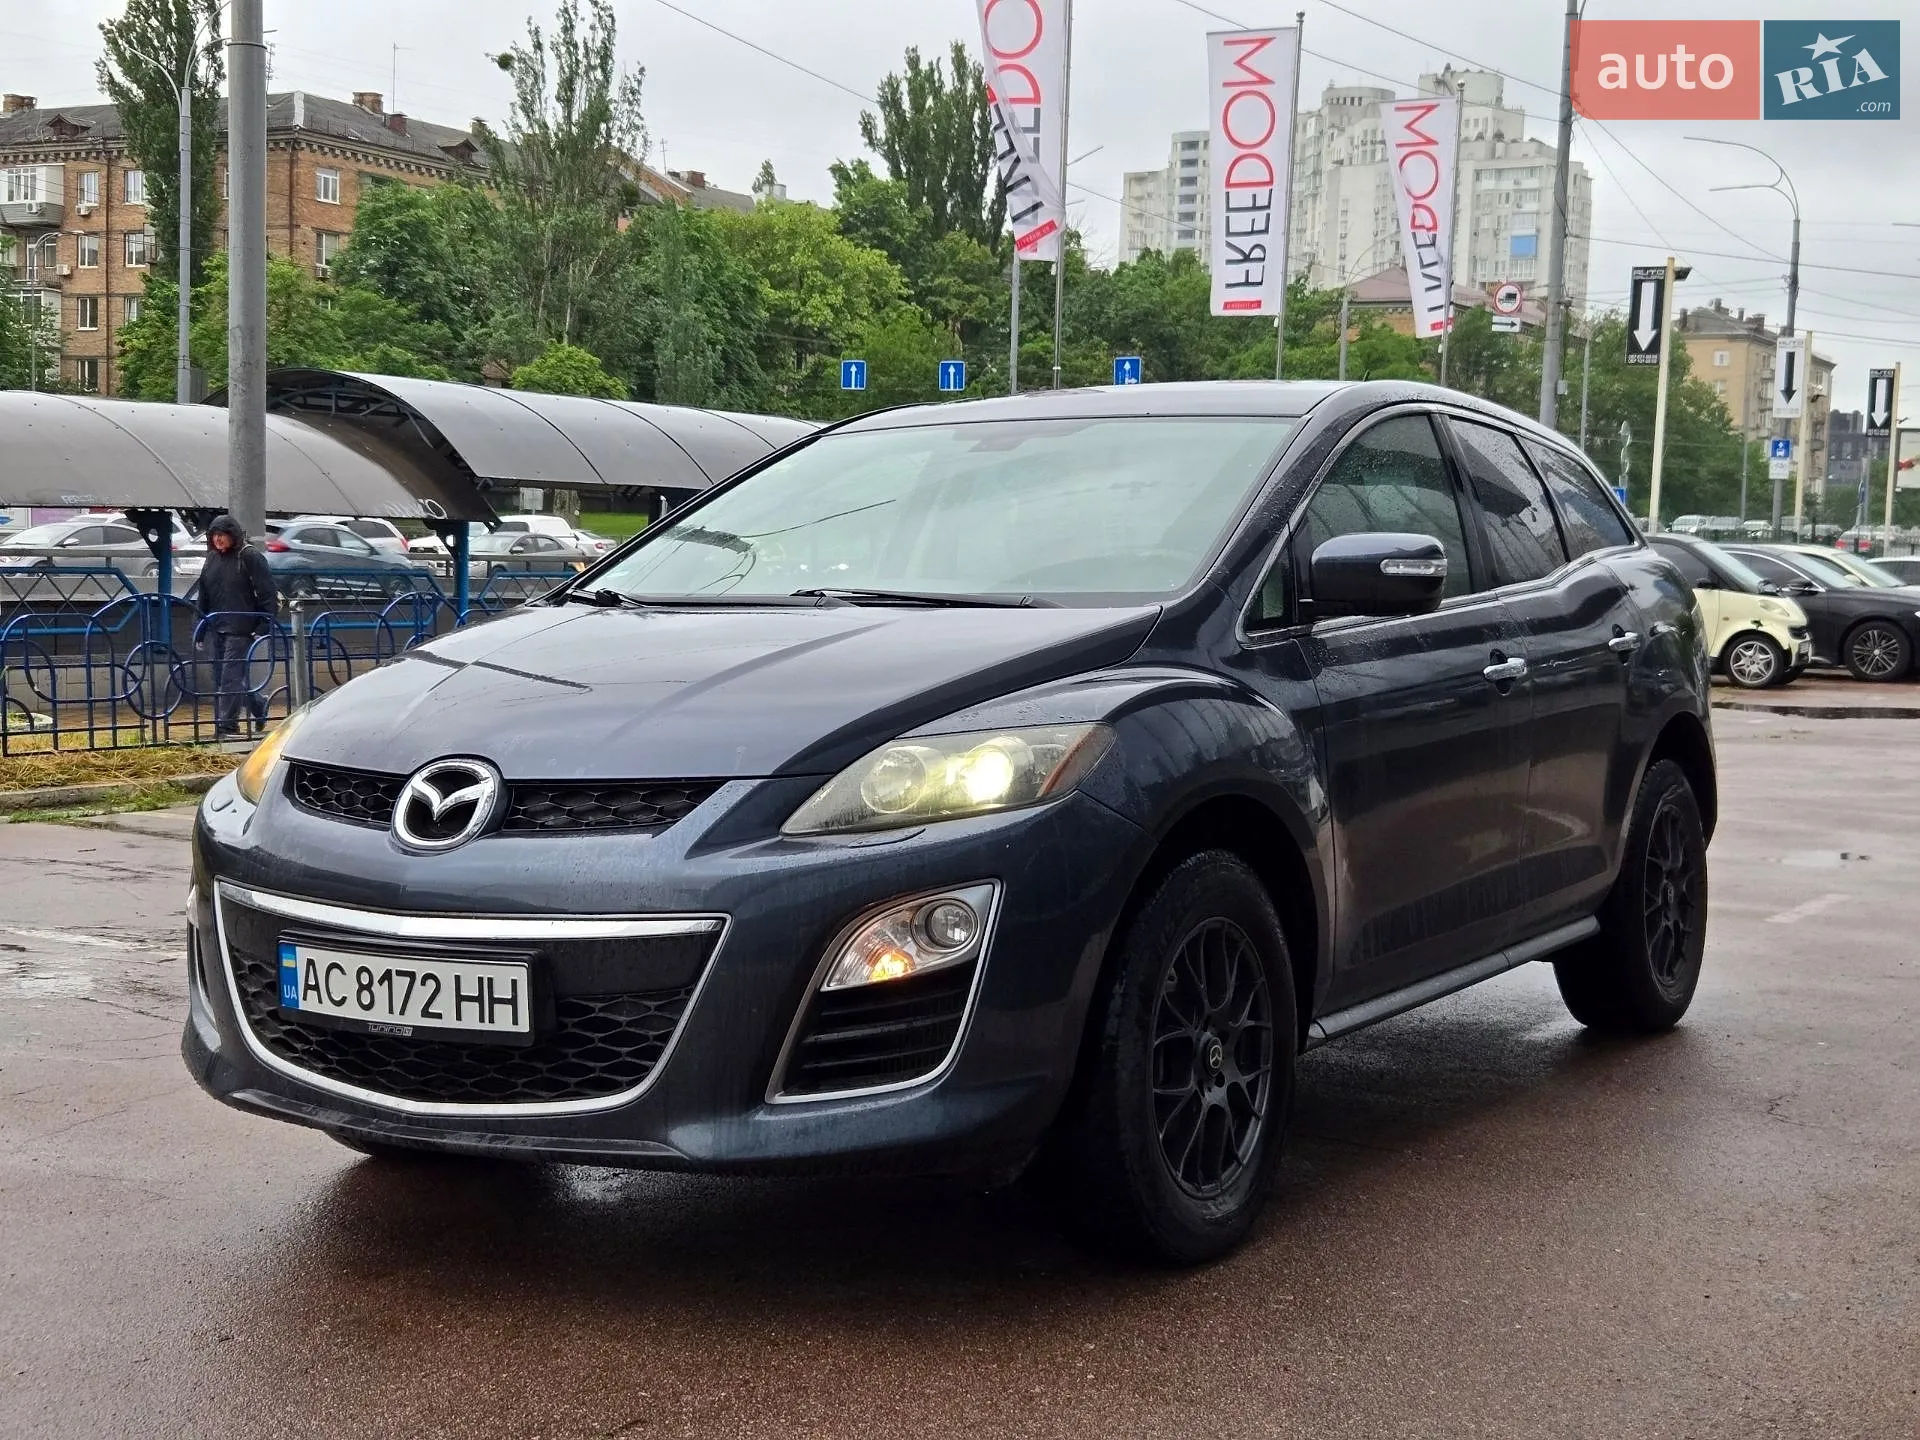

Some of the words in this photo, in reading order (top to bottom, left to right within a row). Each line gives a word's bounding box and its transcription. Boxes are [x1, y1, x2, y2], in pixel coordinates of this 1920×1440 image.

[1633, 269, 1665, 277] AUTO
[284, 984, 298, 1000] UA
[302, 957, 347, 1007] AC
[355, 965, 443, 1020] 8172
[454, 974, 519, 1026] HH
